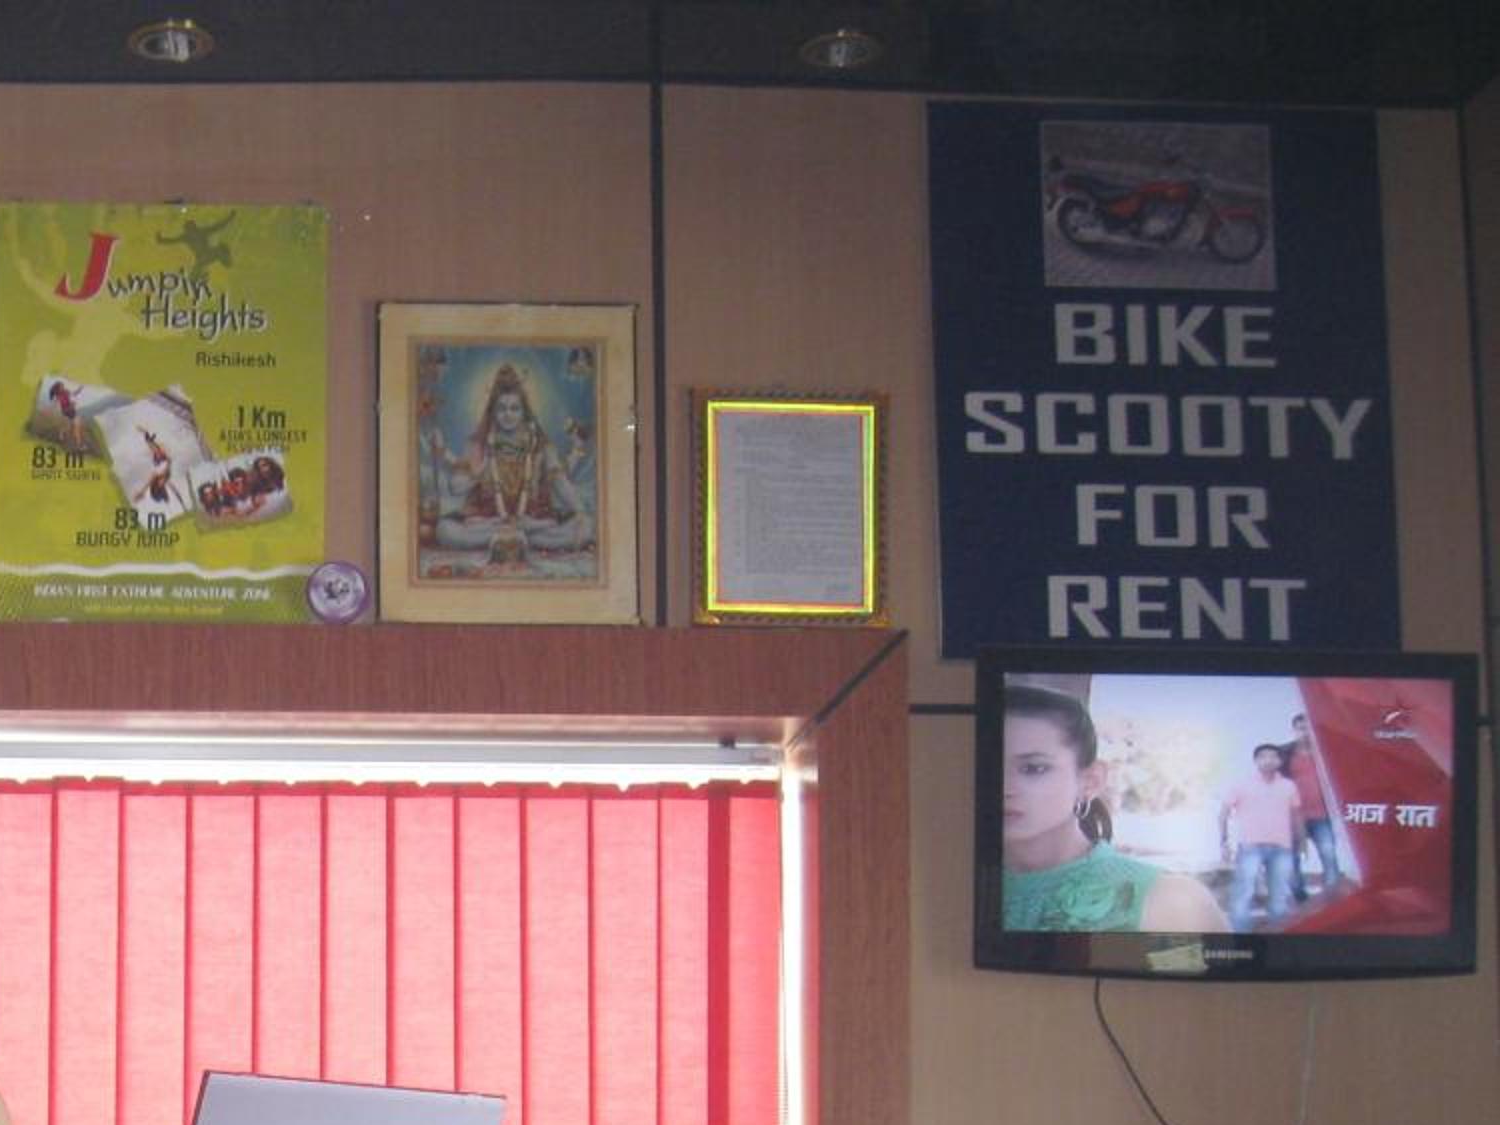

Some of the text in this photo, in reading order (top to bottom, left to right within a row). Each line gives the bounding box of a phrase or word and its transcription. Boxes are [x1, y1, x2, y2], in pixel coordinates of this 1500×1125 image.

[54, 231, 213, 301] Jumpin
[141, 291, 267, 342] Heights
[1054, 303, 1277, 367] BIKE
[195, 351, 277, 370] Rishikesh
[236, 405, 287, 429] 1 Km
[964, 391, 1371, 460] SCOOTY
[32, 447, 84, 469] 83 m
[115, 507, 167, 530] 83 m
[1076, 483, 1270, 549] FOR
[135, 531, 180, 548] JUMP
[1047, 575, 1307, 641] RENT
[1345, 803, 1438, 828] आज रात
